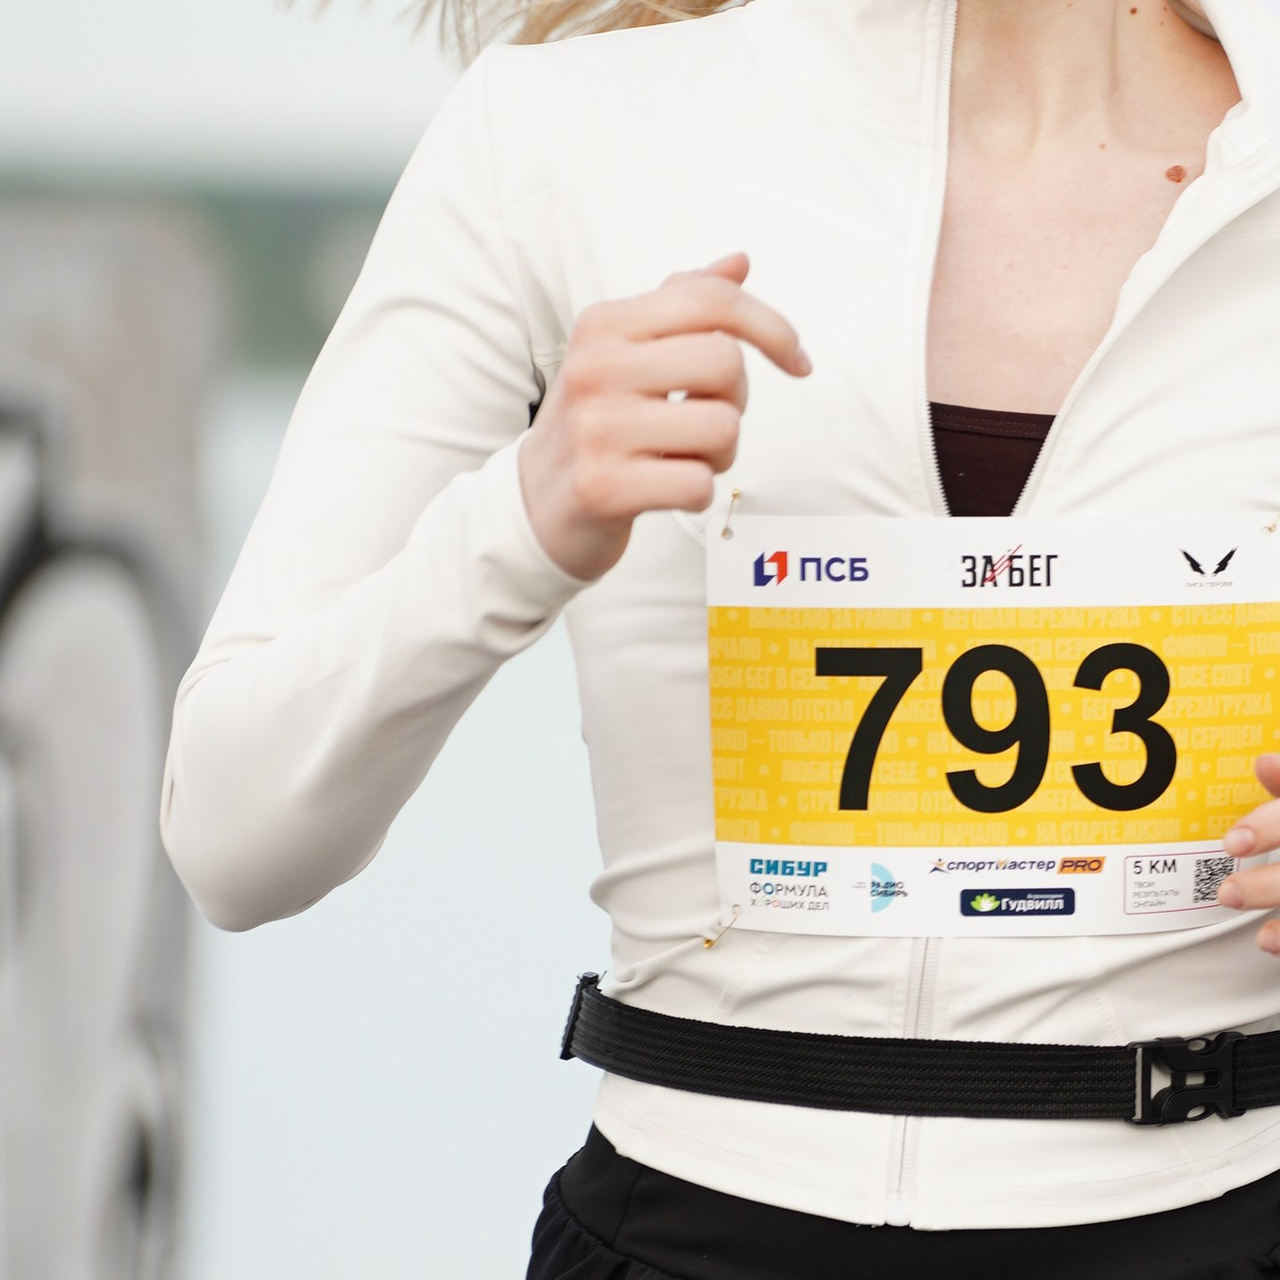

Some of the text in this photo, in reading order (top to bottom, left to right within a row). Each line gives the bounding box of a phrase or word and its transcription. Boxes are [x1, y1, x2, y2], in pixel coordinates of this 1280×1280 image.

[799, 556, 869, 582] ПСБ
[815, 642, 1178, 813] 793
[750, 858, 828, 877] СИБУР
[1059, 858, 1103, 873] PRO
[1133, 860, 1143, 875] 5
[750, 881, 828, 898] ФОРМУЛА
[1001, 897, 1065, 913] Гудвилл
